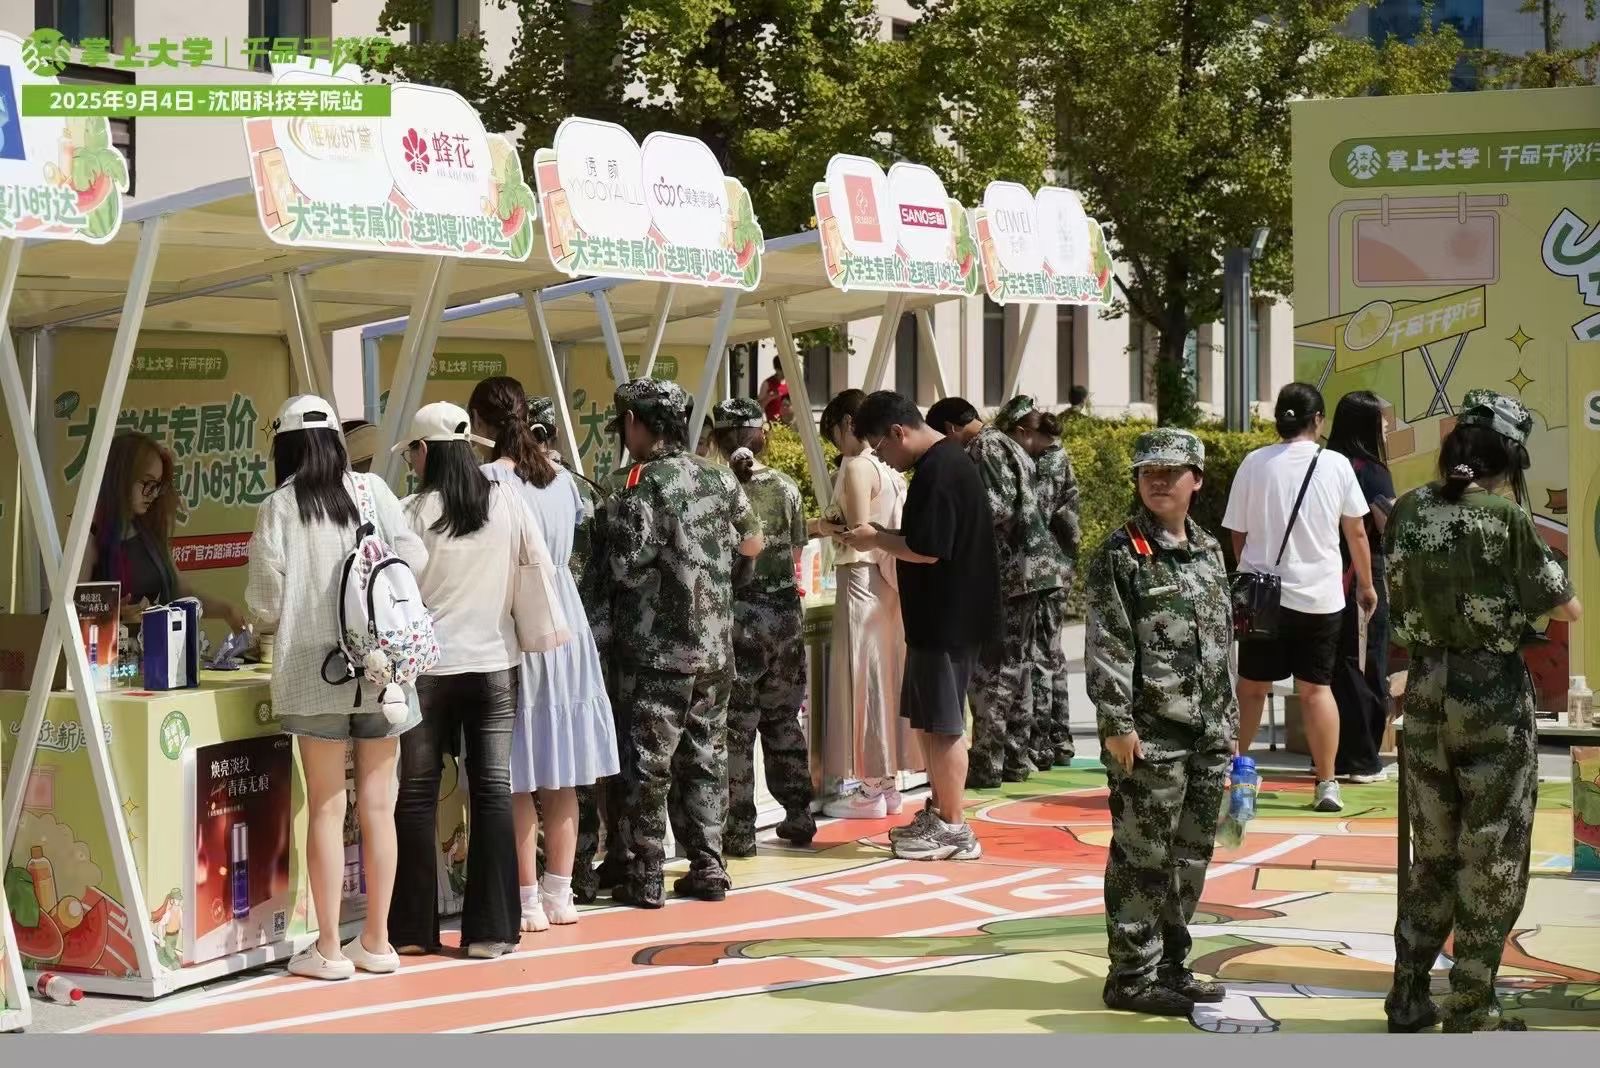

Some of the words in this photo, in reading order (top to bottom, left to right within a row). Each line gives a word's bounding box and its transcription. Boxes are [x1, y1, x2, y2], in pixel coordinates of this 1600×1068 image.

[431, 131, 475, 169] 蜂花
[1386, 147, 1480, 172] 掌上大学
[288, 197, 403, 242] 大学生专属价
[409, 208, 512, 250] 送到寝小时达
[569, 232, 660, 271] 大学生专属价
[664, 245, 744, 280] 送到寝小时达
[840, 252, 905, 286] 大学生专属价
[998, 272, 1051, 296] 大学生专属价
[174, 454, 280, 508] 小时达
[228, 774, 269, 797] 青春无痕
